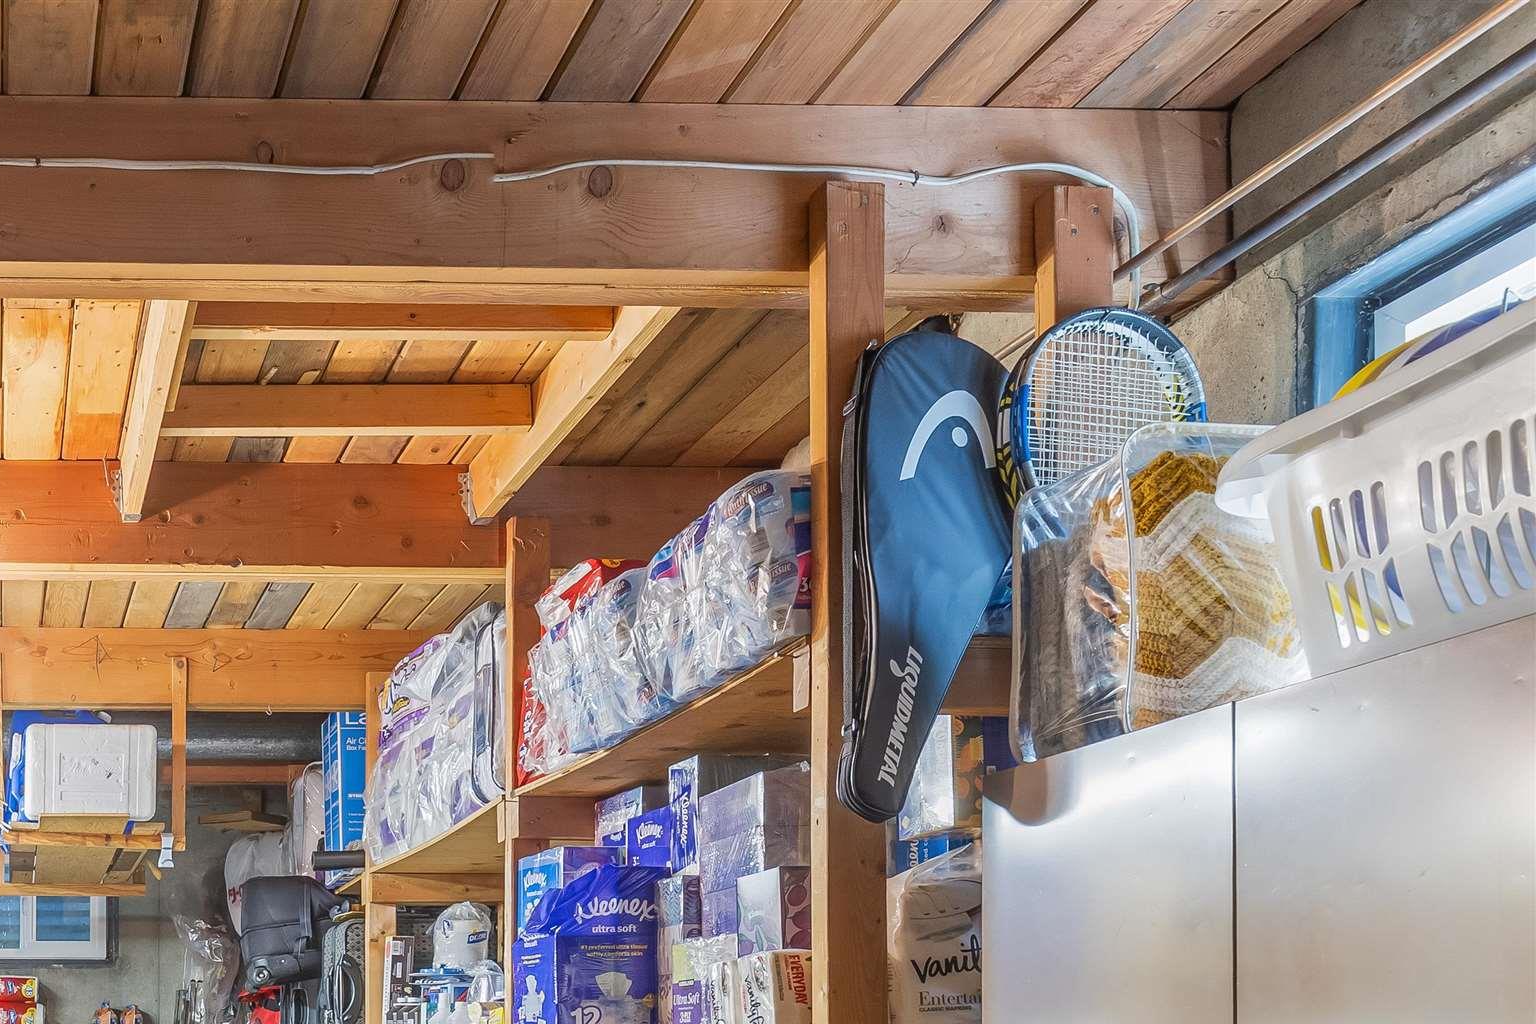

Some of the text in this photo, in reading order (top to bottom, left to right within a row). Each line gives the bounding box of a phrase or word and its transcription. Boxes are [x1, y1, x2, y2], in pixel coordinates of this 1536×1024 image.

[877, 646, 923, 787] LIQUIDMETAL
[574, 896, 659, 924] Kleenex
[592, 924, 637, 933] ultra soft
[789, 954, 808, 1005] EVERYDAY
